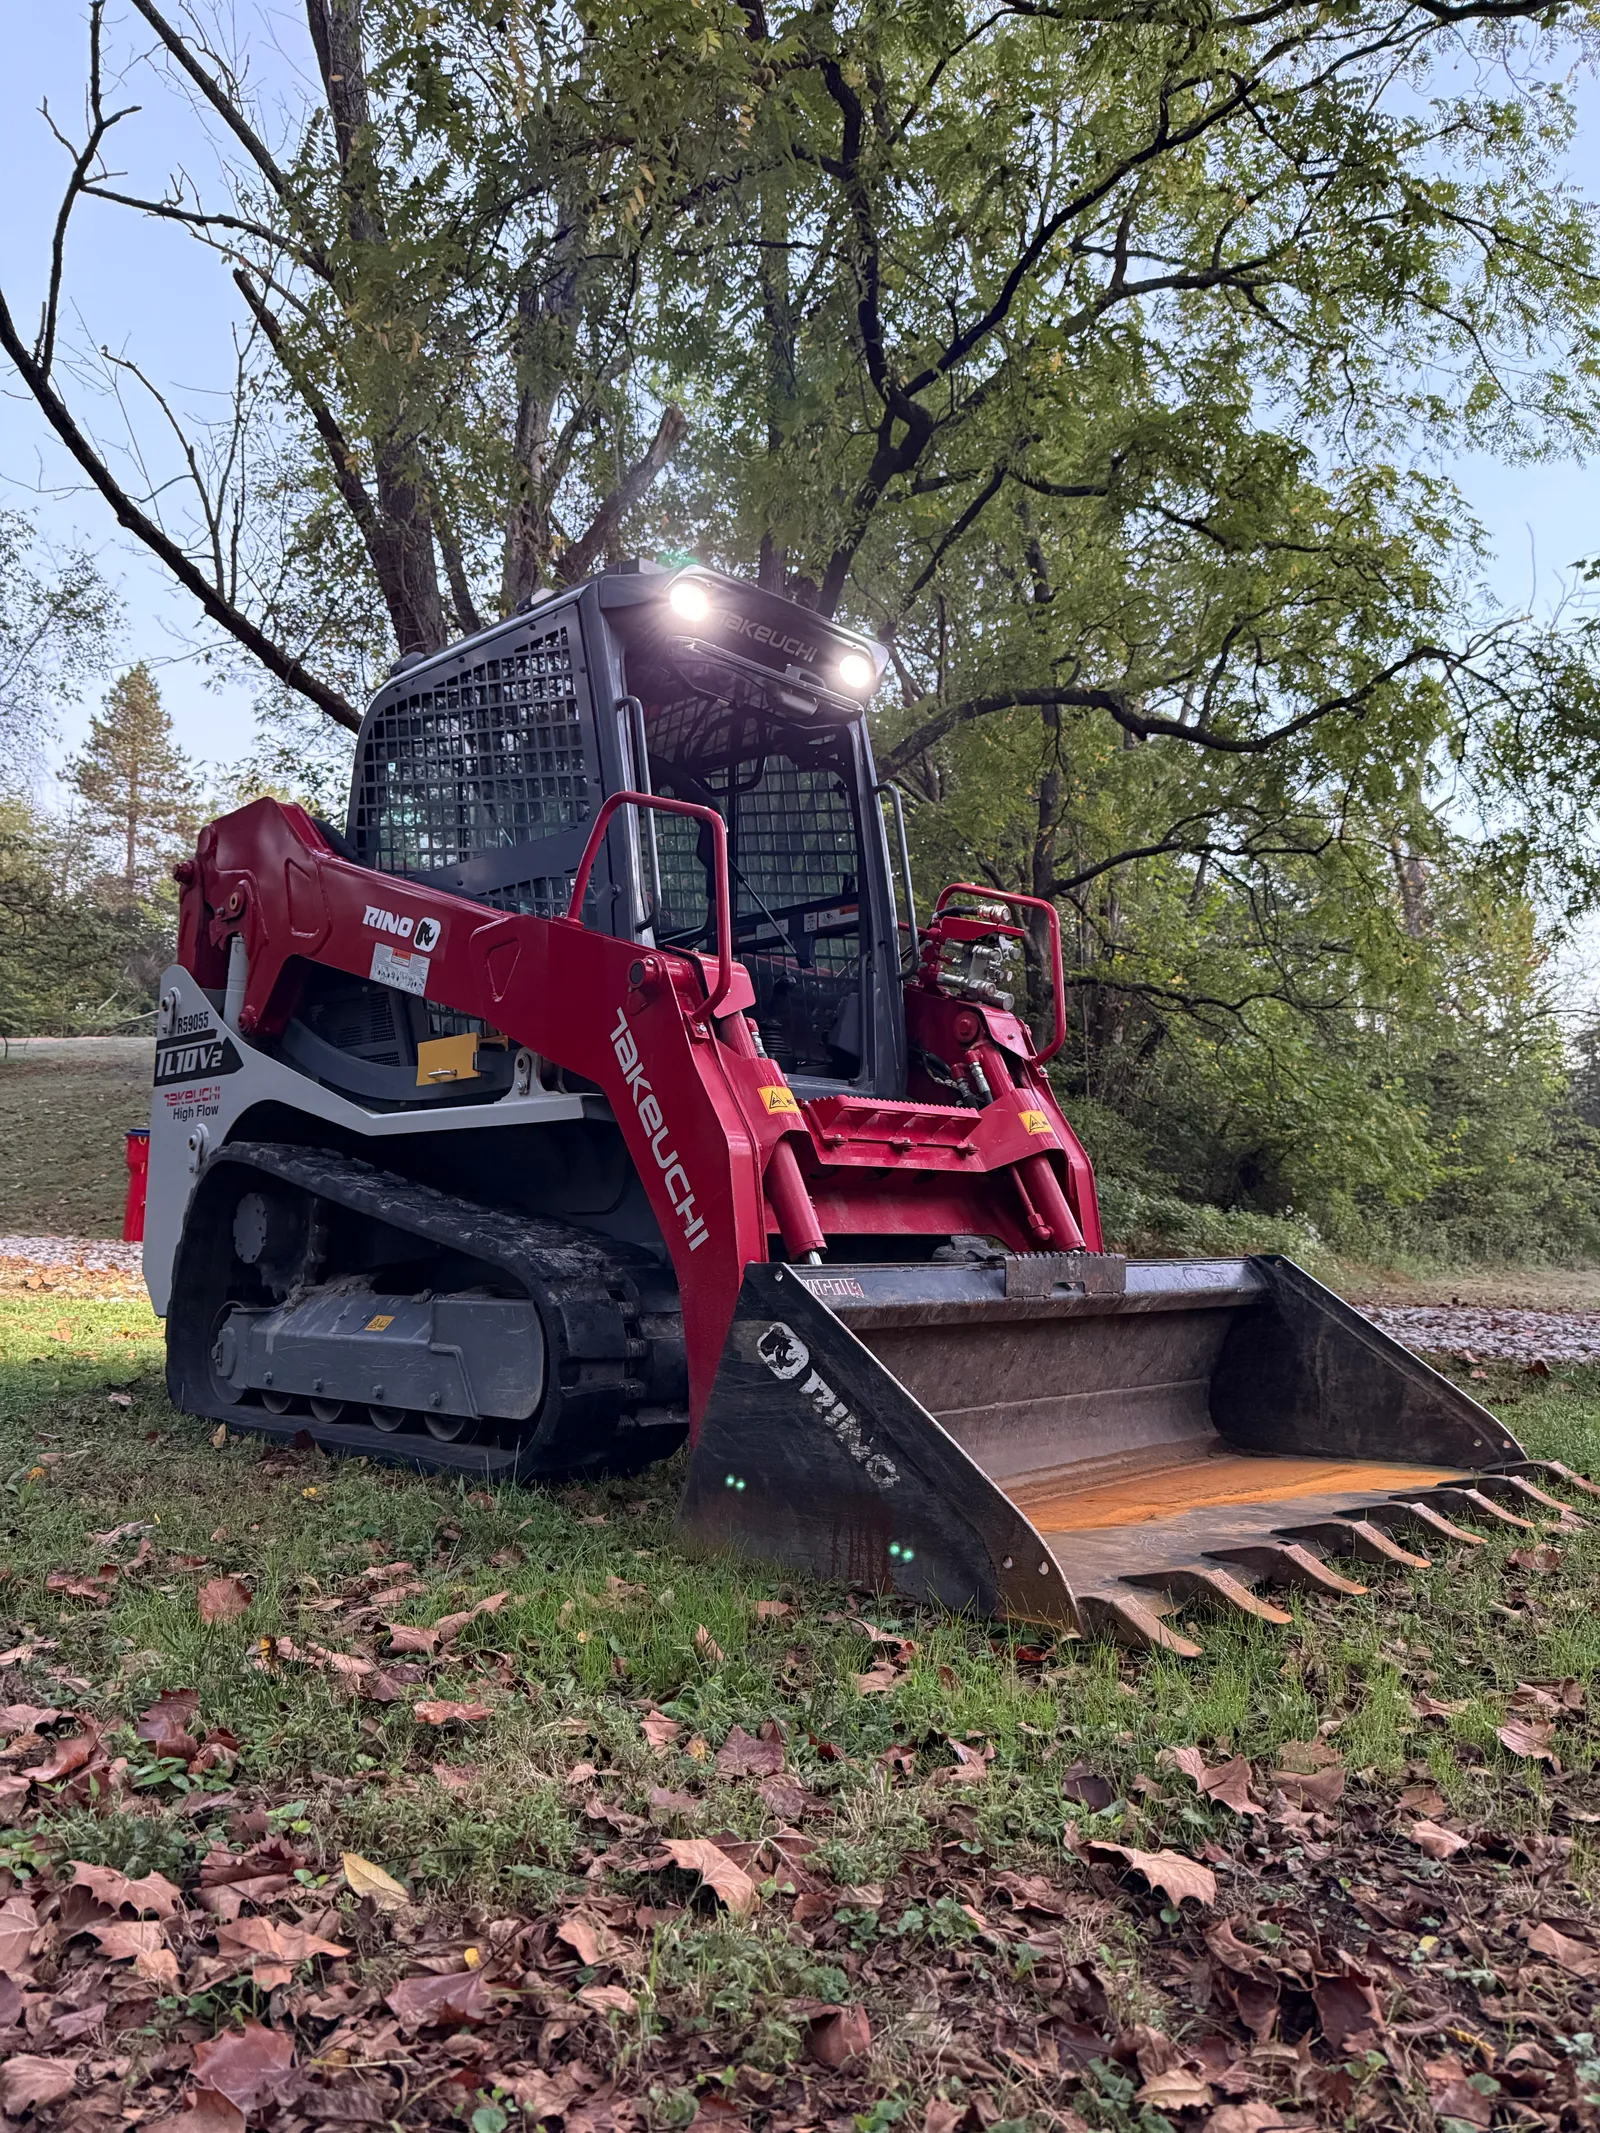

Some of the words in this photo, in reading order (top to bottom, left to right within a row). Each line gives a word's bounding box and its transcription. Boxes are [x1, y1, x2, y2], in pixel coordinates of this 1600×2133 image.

[362, 904, 414, 938] RINO
[177, 1011, 209, 1034] R59055
[156, 1044, 223, 1078] TL10V2
[173, 1107, 194, 1122] High
[196, 1104, 219, 1117] Flow
[610, 1007, 709, 1251] TAKEUCHI
